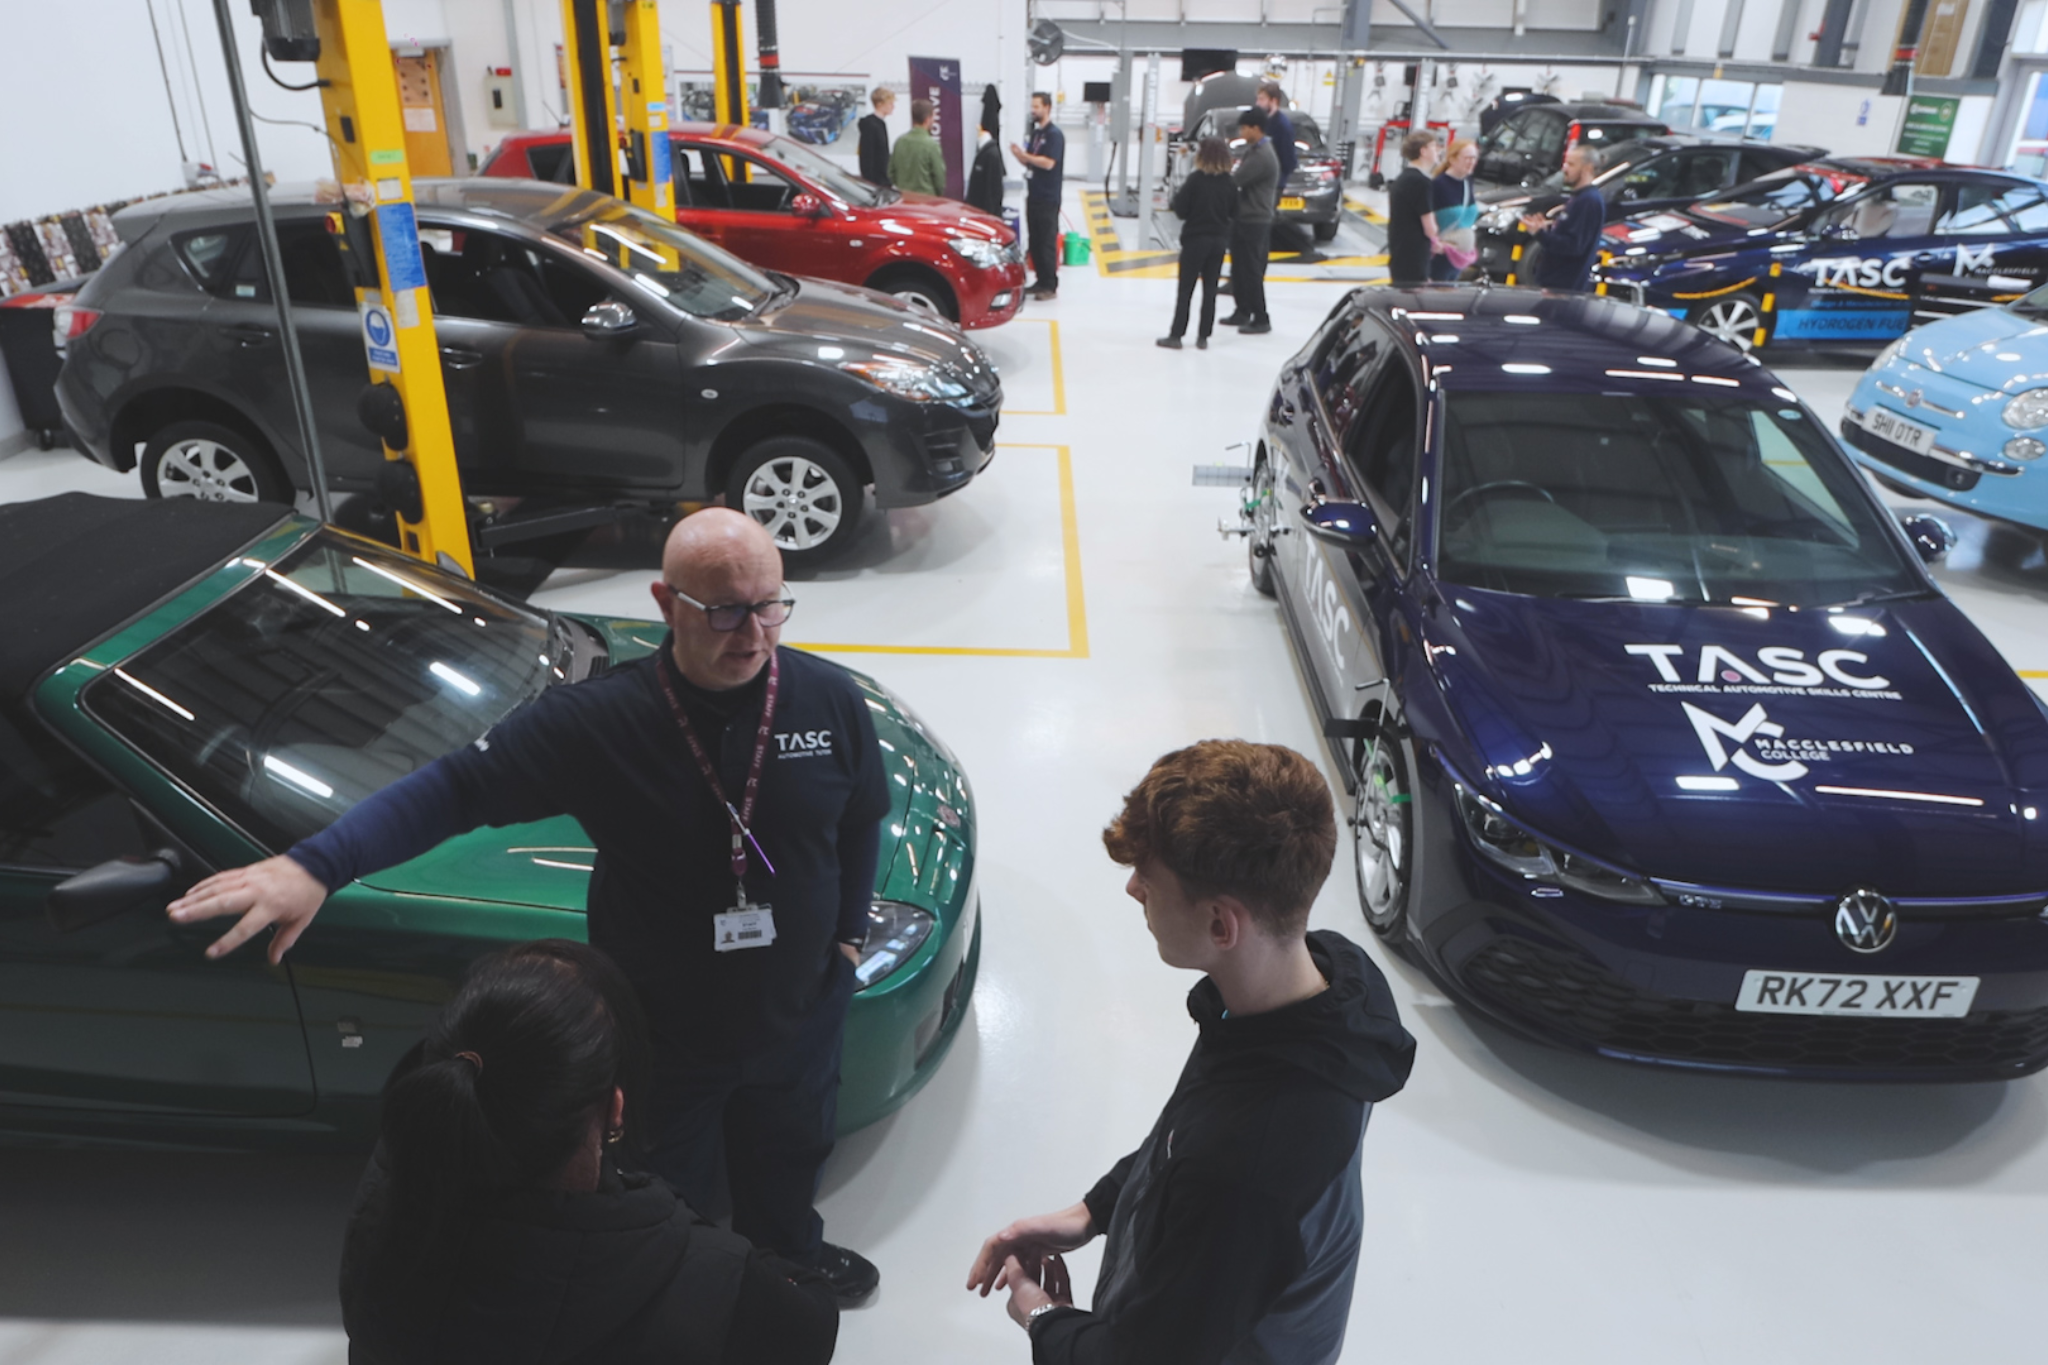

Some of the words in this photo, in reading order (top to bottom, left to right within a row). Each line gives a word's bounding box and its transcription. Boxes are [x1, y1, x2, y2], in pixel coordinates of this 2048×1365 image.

[1809, 257, 1909, 287] TASC
[1798, 316, 1876, 331] HYDROGEN
[1306, 531, 1349, 670] TASC
[1624, 644, 1890, 690] TASC
[1647, 683, 1721, 693] TECHNICAL
[1723, 684, 1806, 696] AUTOMOTIVE
[1806, 687, 1851, 697] SKILLS
[1851, 689, 1903, 701] CENTRE
[774, 730, 832, 751] TASC
[1755, 739, 1914, 755] MACCLESFIELD
[1761, 750, 1830, 761] COLLEGE
[1756, 975, 1868, 1009] RK72
[1874, 980, 1960, 1010] XXF
